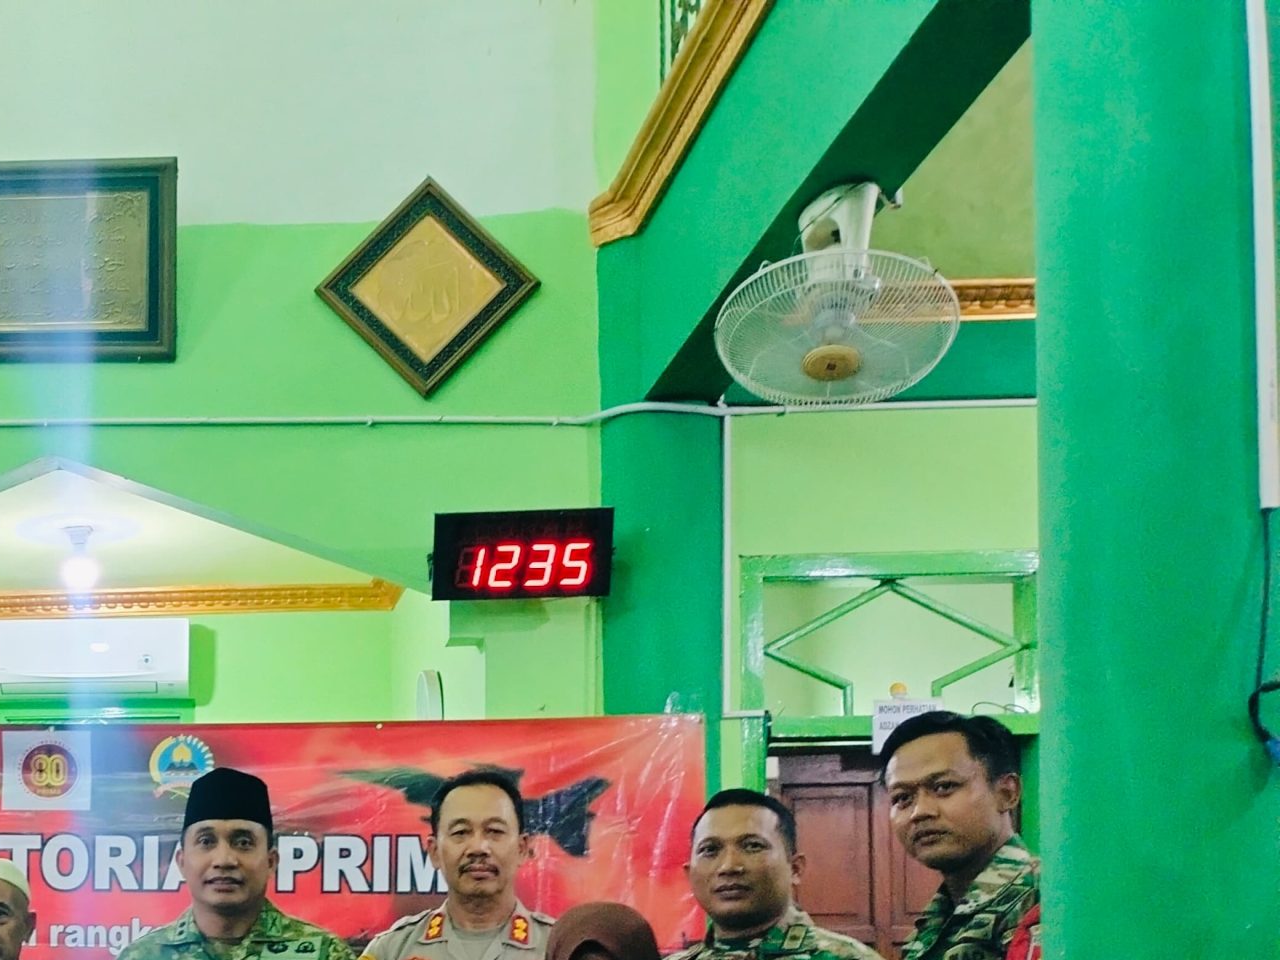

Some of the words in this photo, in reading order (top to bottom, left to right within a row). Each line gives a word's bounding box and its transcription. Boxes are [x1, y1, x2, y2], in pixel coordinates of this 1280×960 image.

[472, 543, 591, 588] 1235
[276, 835, 449, 892] PRIM
[49, 918, 157, 956] rangk
